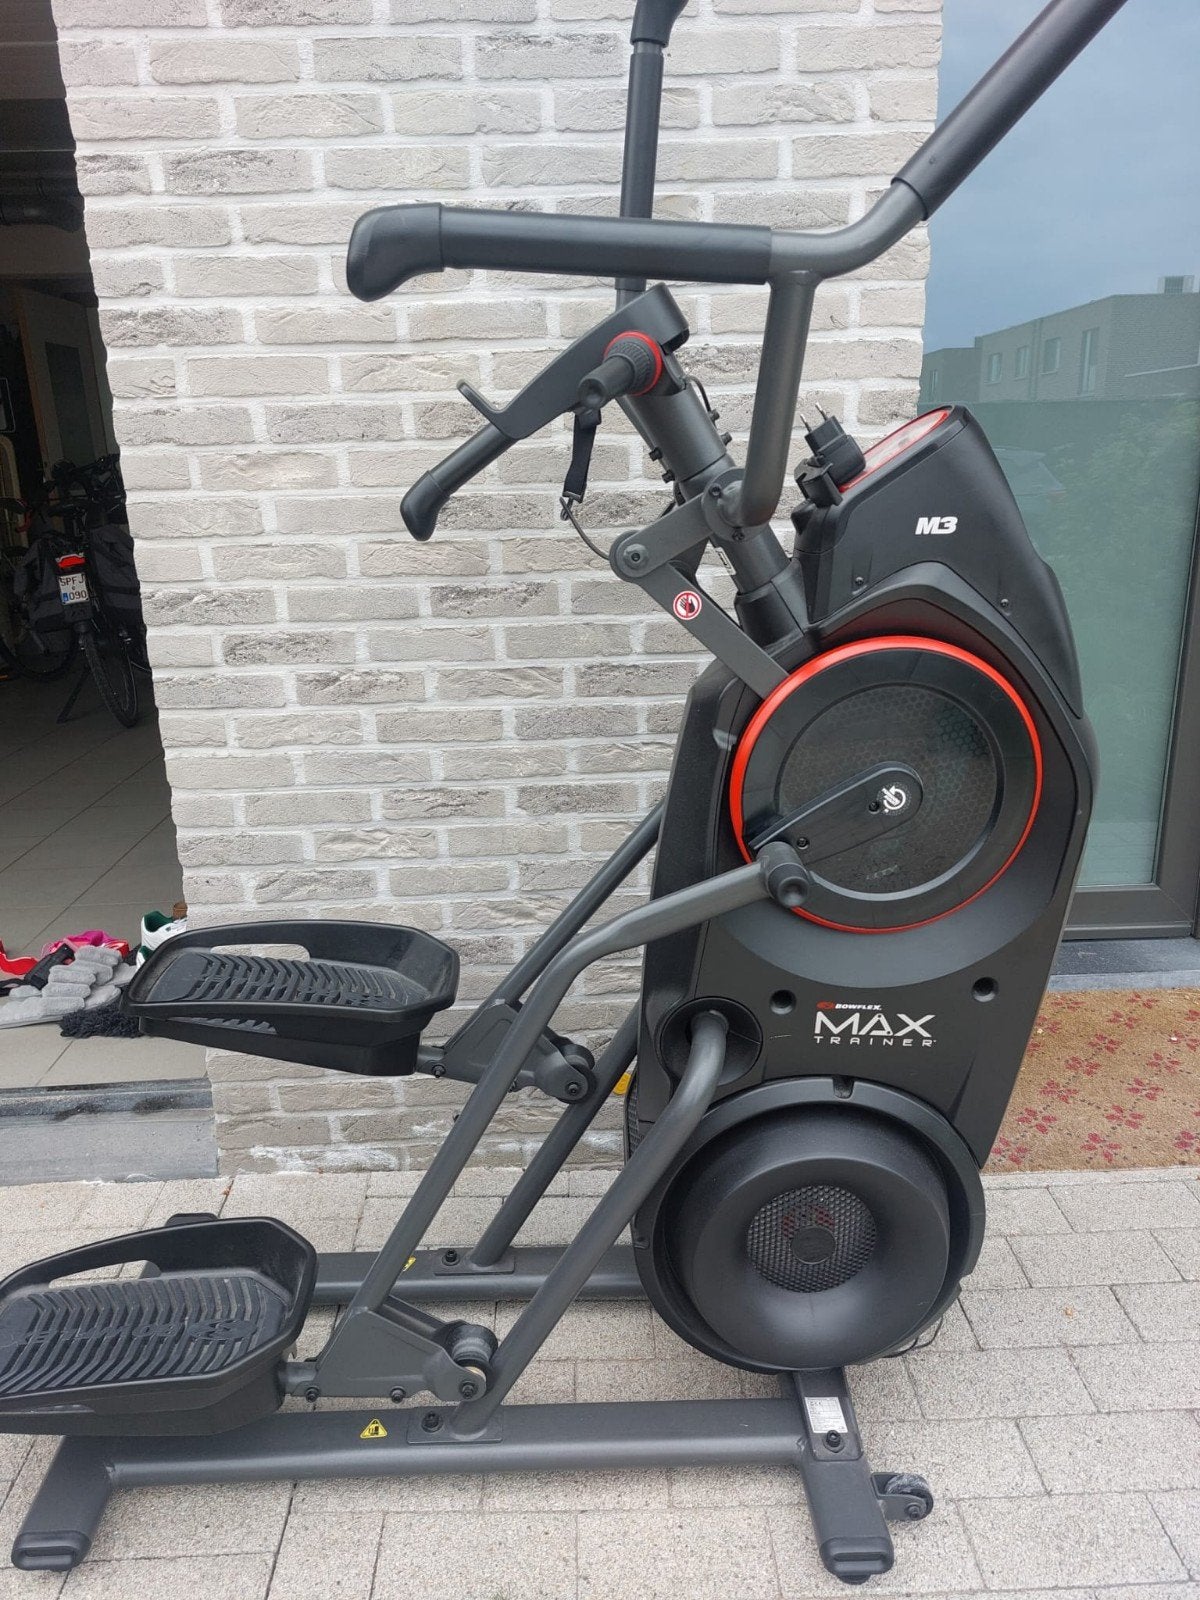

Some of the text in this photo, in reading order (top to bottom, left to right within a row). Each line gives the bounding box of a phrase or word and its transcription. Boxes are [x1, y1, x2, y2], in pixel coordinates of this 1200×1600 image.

[915, 516, 958, 535] M3
[69, 590, 87, 601] 090
[814, 1011, 936, 1038] MAX
[814, 1036, 934, 1047] TRAINER
